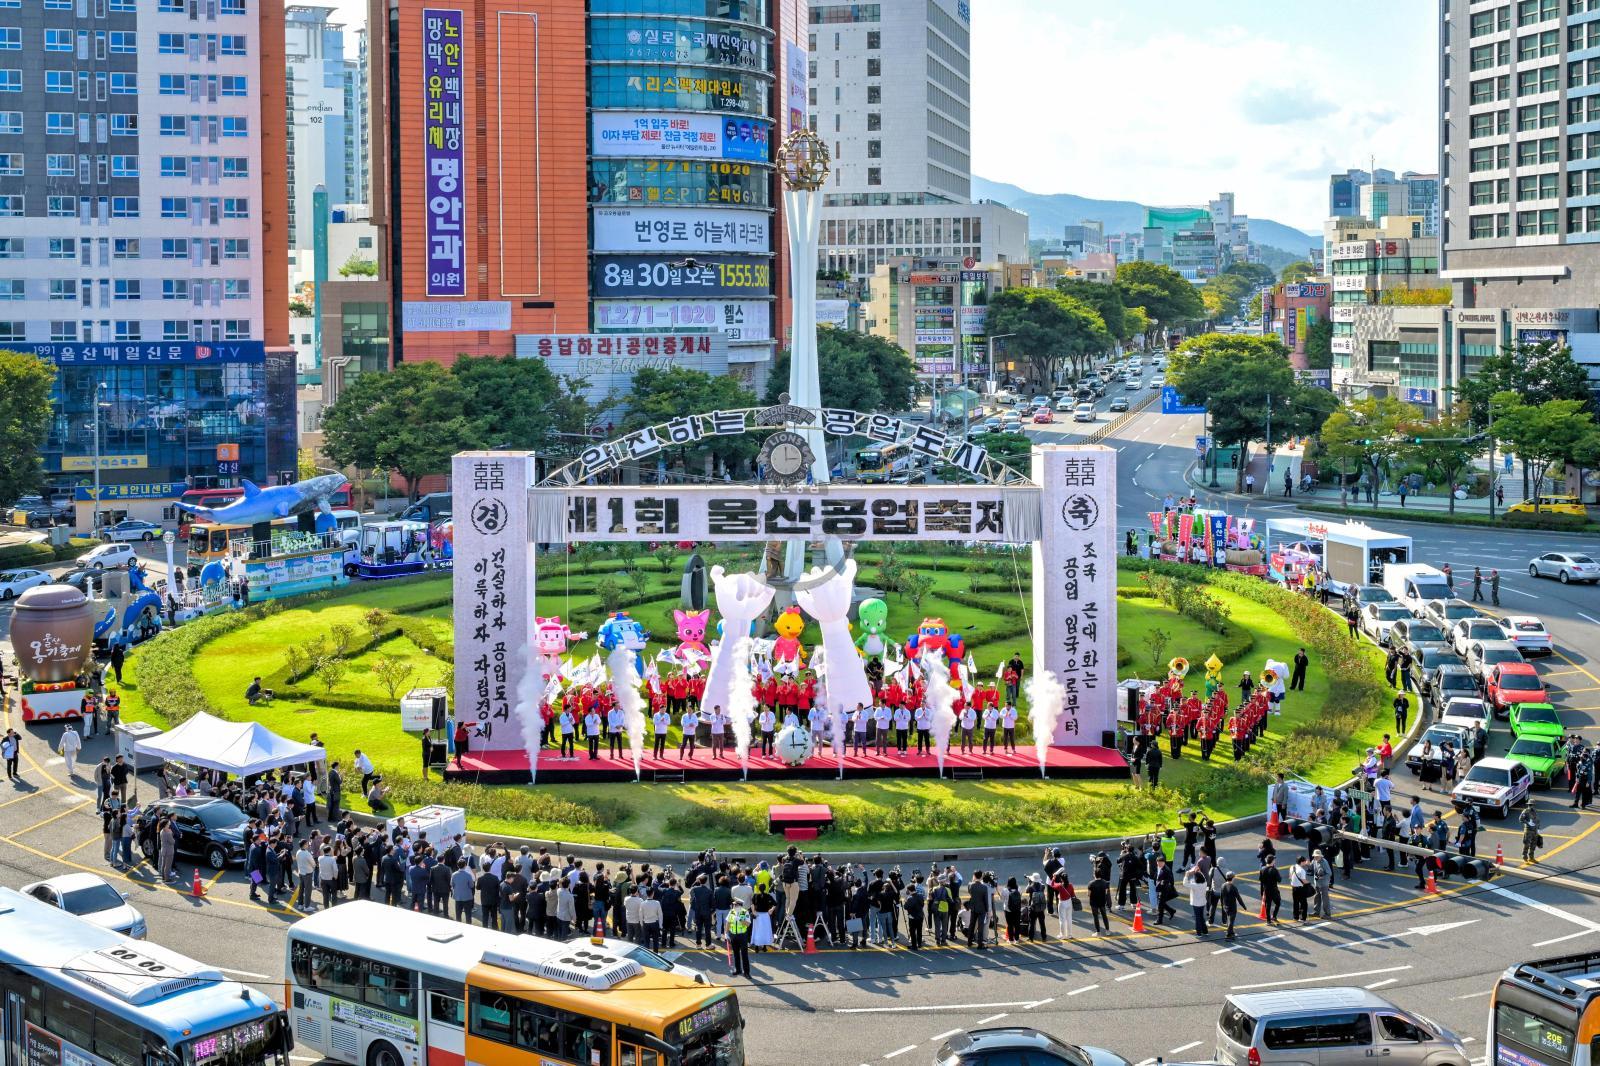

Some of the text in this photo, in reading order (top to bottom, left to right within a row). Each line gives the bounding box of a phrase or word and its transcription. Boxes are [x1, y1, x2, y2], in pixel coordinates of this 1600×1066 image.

[427, 17, 444, 150] 망막·유리체
[444, 18, 461, 150] 노안·백내장
[602, 130, 716, 143] 이자 부담 제로! 잔금 걱정 제로!
[651, 118, 670, 131] 입주
[670, 119, 690, 131] 바로!
[429, 157, 463, 269] 명안과
[635, 220, 764, 246] 번영로 하늘채 라크뷰
[431, 272, 460, 287] 의원
[604, 263, 634, 287] 8월
[637, 262, 682, 287] 30일
[724, 304, 744, 324] 헬스
[33, 345, 56, 356] 1991
[60, 345, 183, 361] 울산매일신문
[581, 410, 746, 473] 약진하는
[769, 433, 803, 446] LIONS
[824, 408, 988, 476] 공업도시
[477, 503, 500, 531] 경
[707, 496, 1003, 535] 울산공업축제
[1067, 497, 1092, 527] 축
[1081, 542, 1099, 690] 조국 근대화는
[30, 633, 82, 664] 울산 옹기축제
[473, 557, 492, 743] 이룩하자 자립경제
[491, 546, 509, 724] 건설하자 공업도시
[1063, 557, 1080, 737] 공업 입국으로부터
[1546, 1031, 1563, 1045] 205
